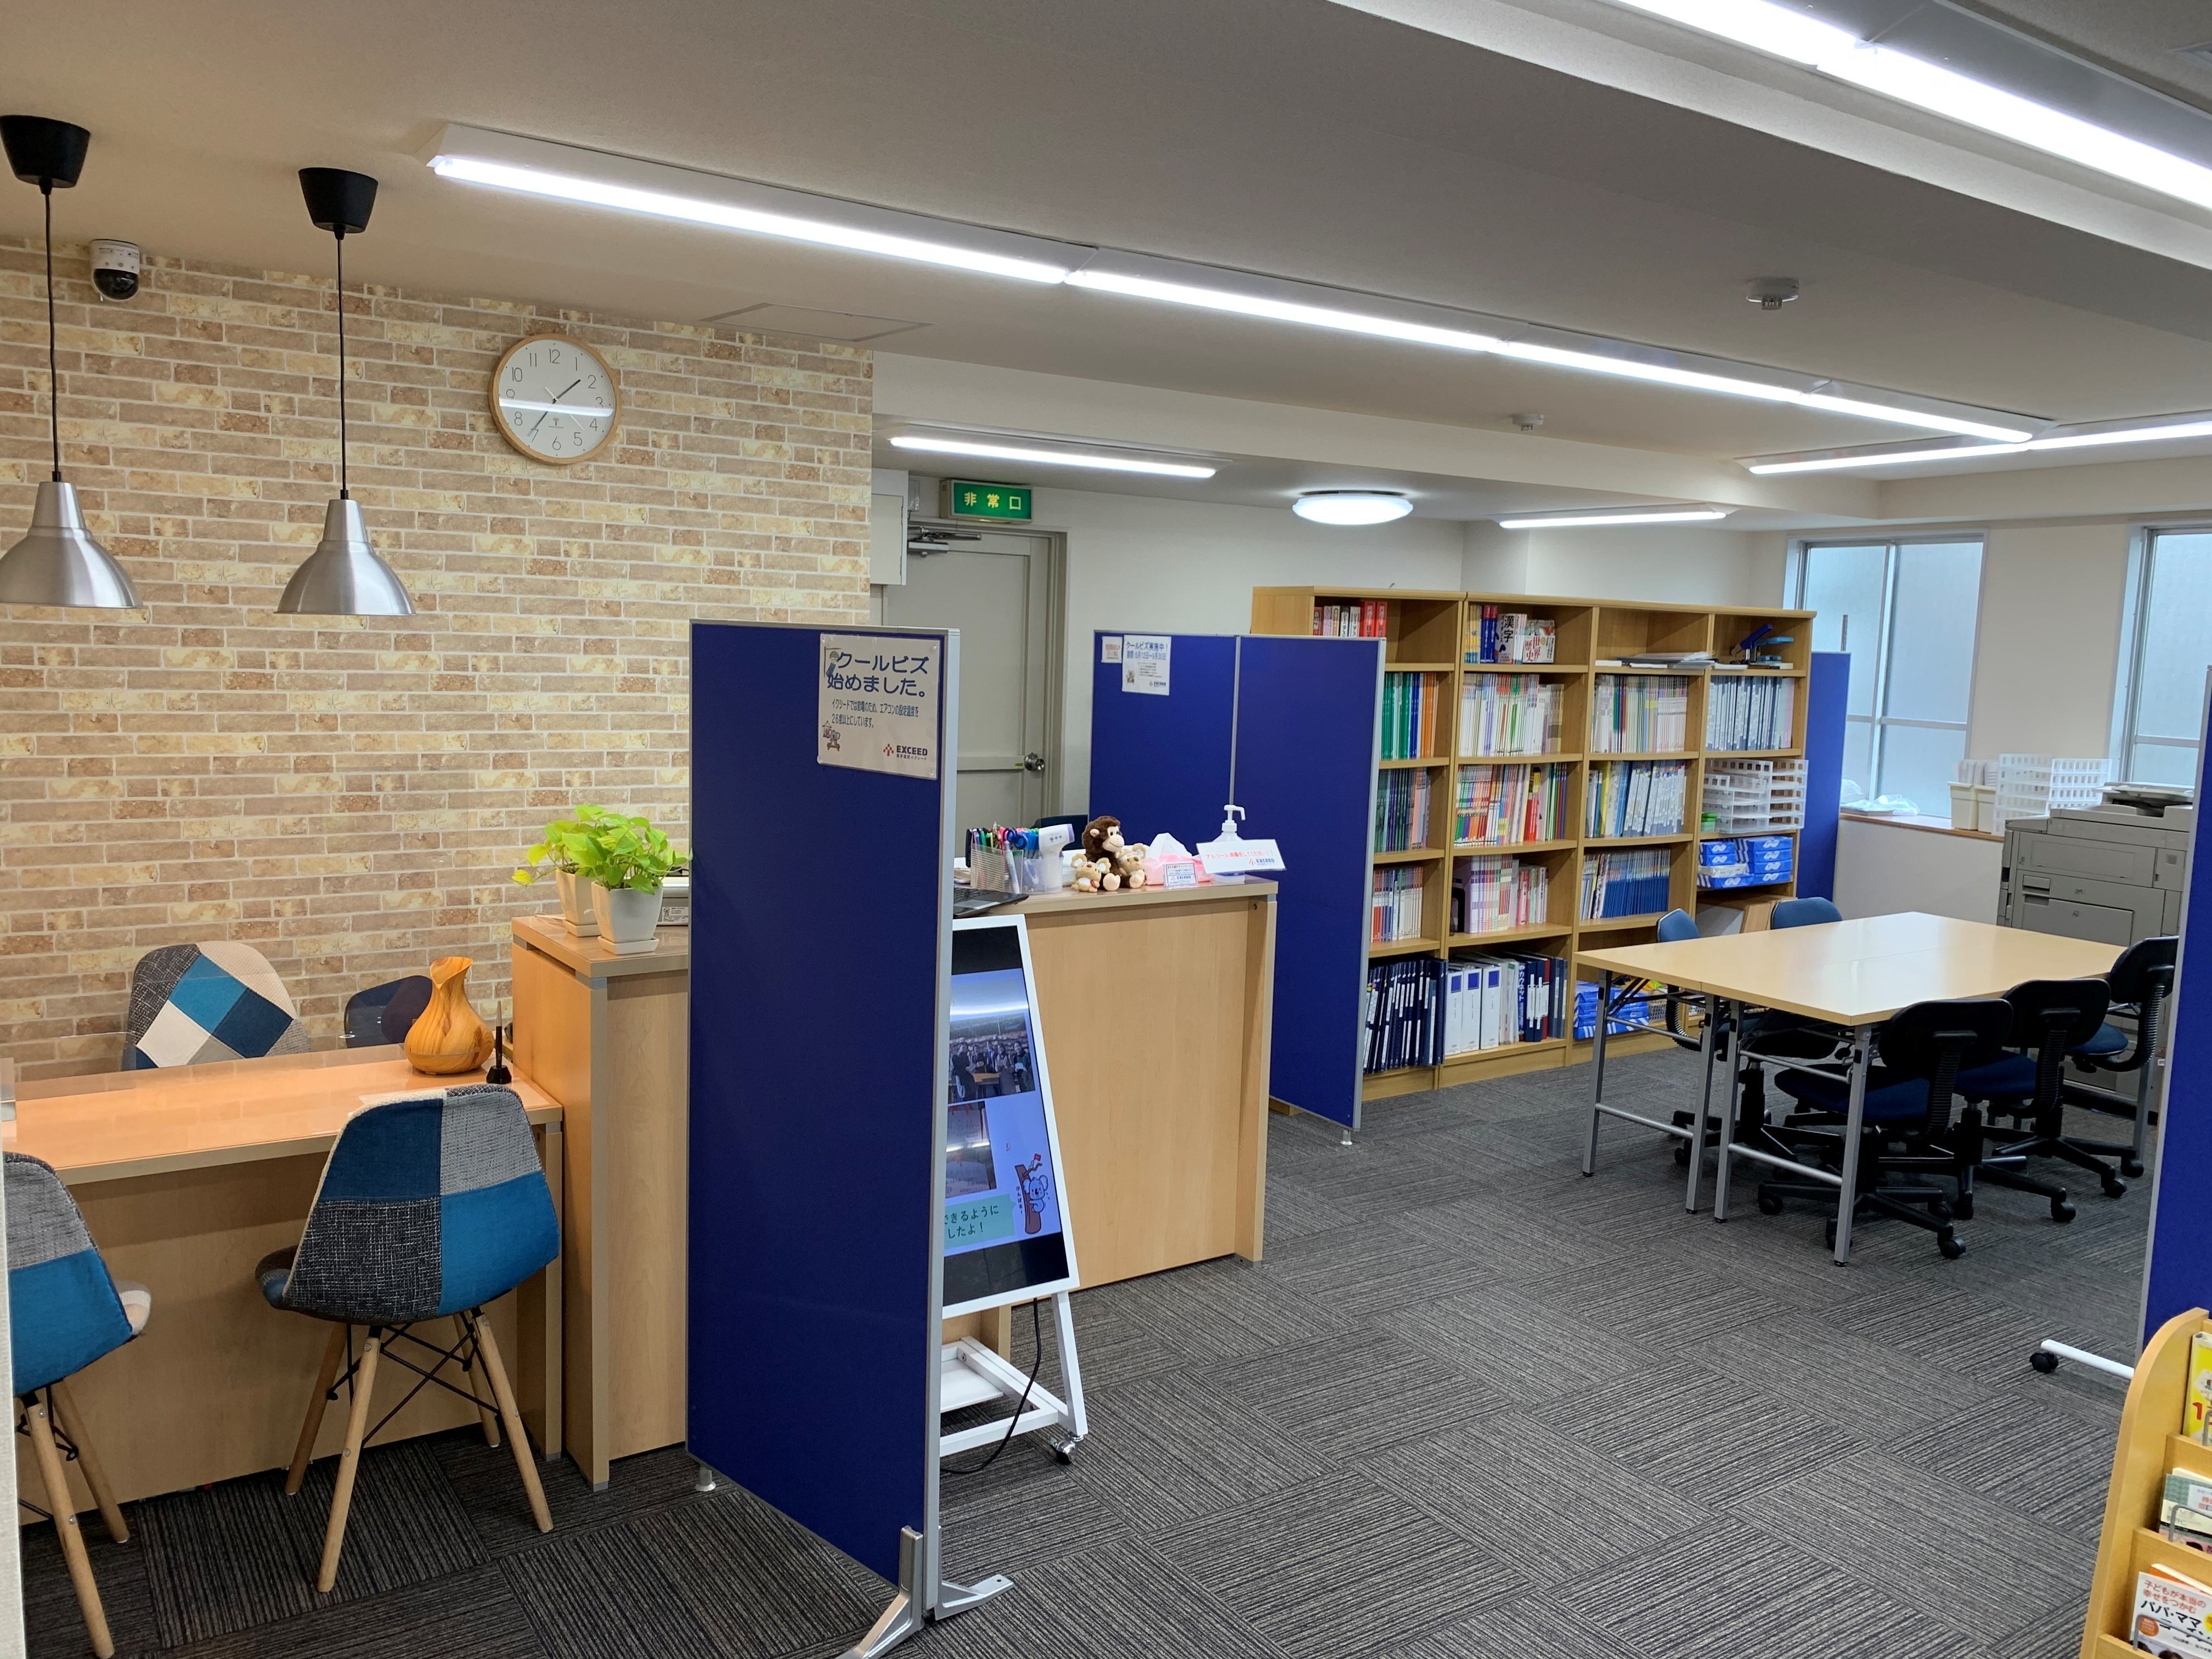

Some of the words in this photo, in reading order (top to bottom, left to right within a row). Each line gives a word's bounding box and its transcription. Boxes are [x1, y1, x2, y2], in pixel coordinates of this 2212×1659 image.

[529, 353, 537, 367] 11
[549, 349, 560, 364] 12
[574, 357, 578, 371] 1
[512, 367, 523, 382] 10
[588, 375, 596, 389] 2
[515, 412, 523, 426] 8
[589, 418, 598, 431] 4
[531, 428, 539, 443] 7
[552, 436, 561, 450] 6
[574, 432, 582, 446] 5
[964, 492, 1021, 510] 非常口
[1504, 615, 1514, 642] 漢字
[837, 652, 929, 674] クールビズ
[827, 673, 925, 697] 始めました。
[896, 745, 928, 757] EXCEED
[2143, 1589, 2197, 1614] 幸せをつかむ
[2145, 1580, 2206, 1608] 子どもが本当の
